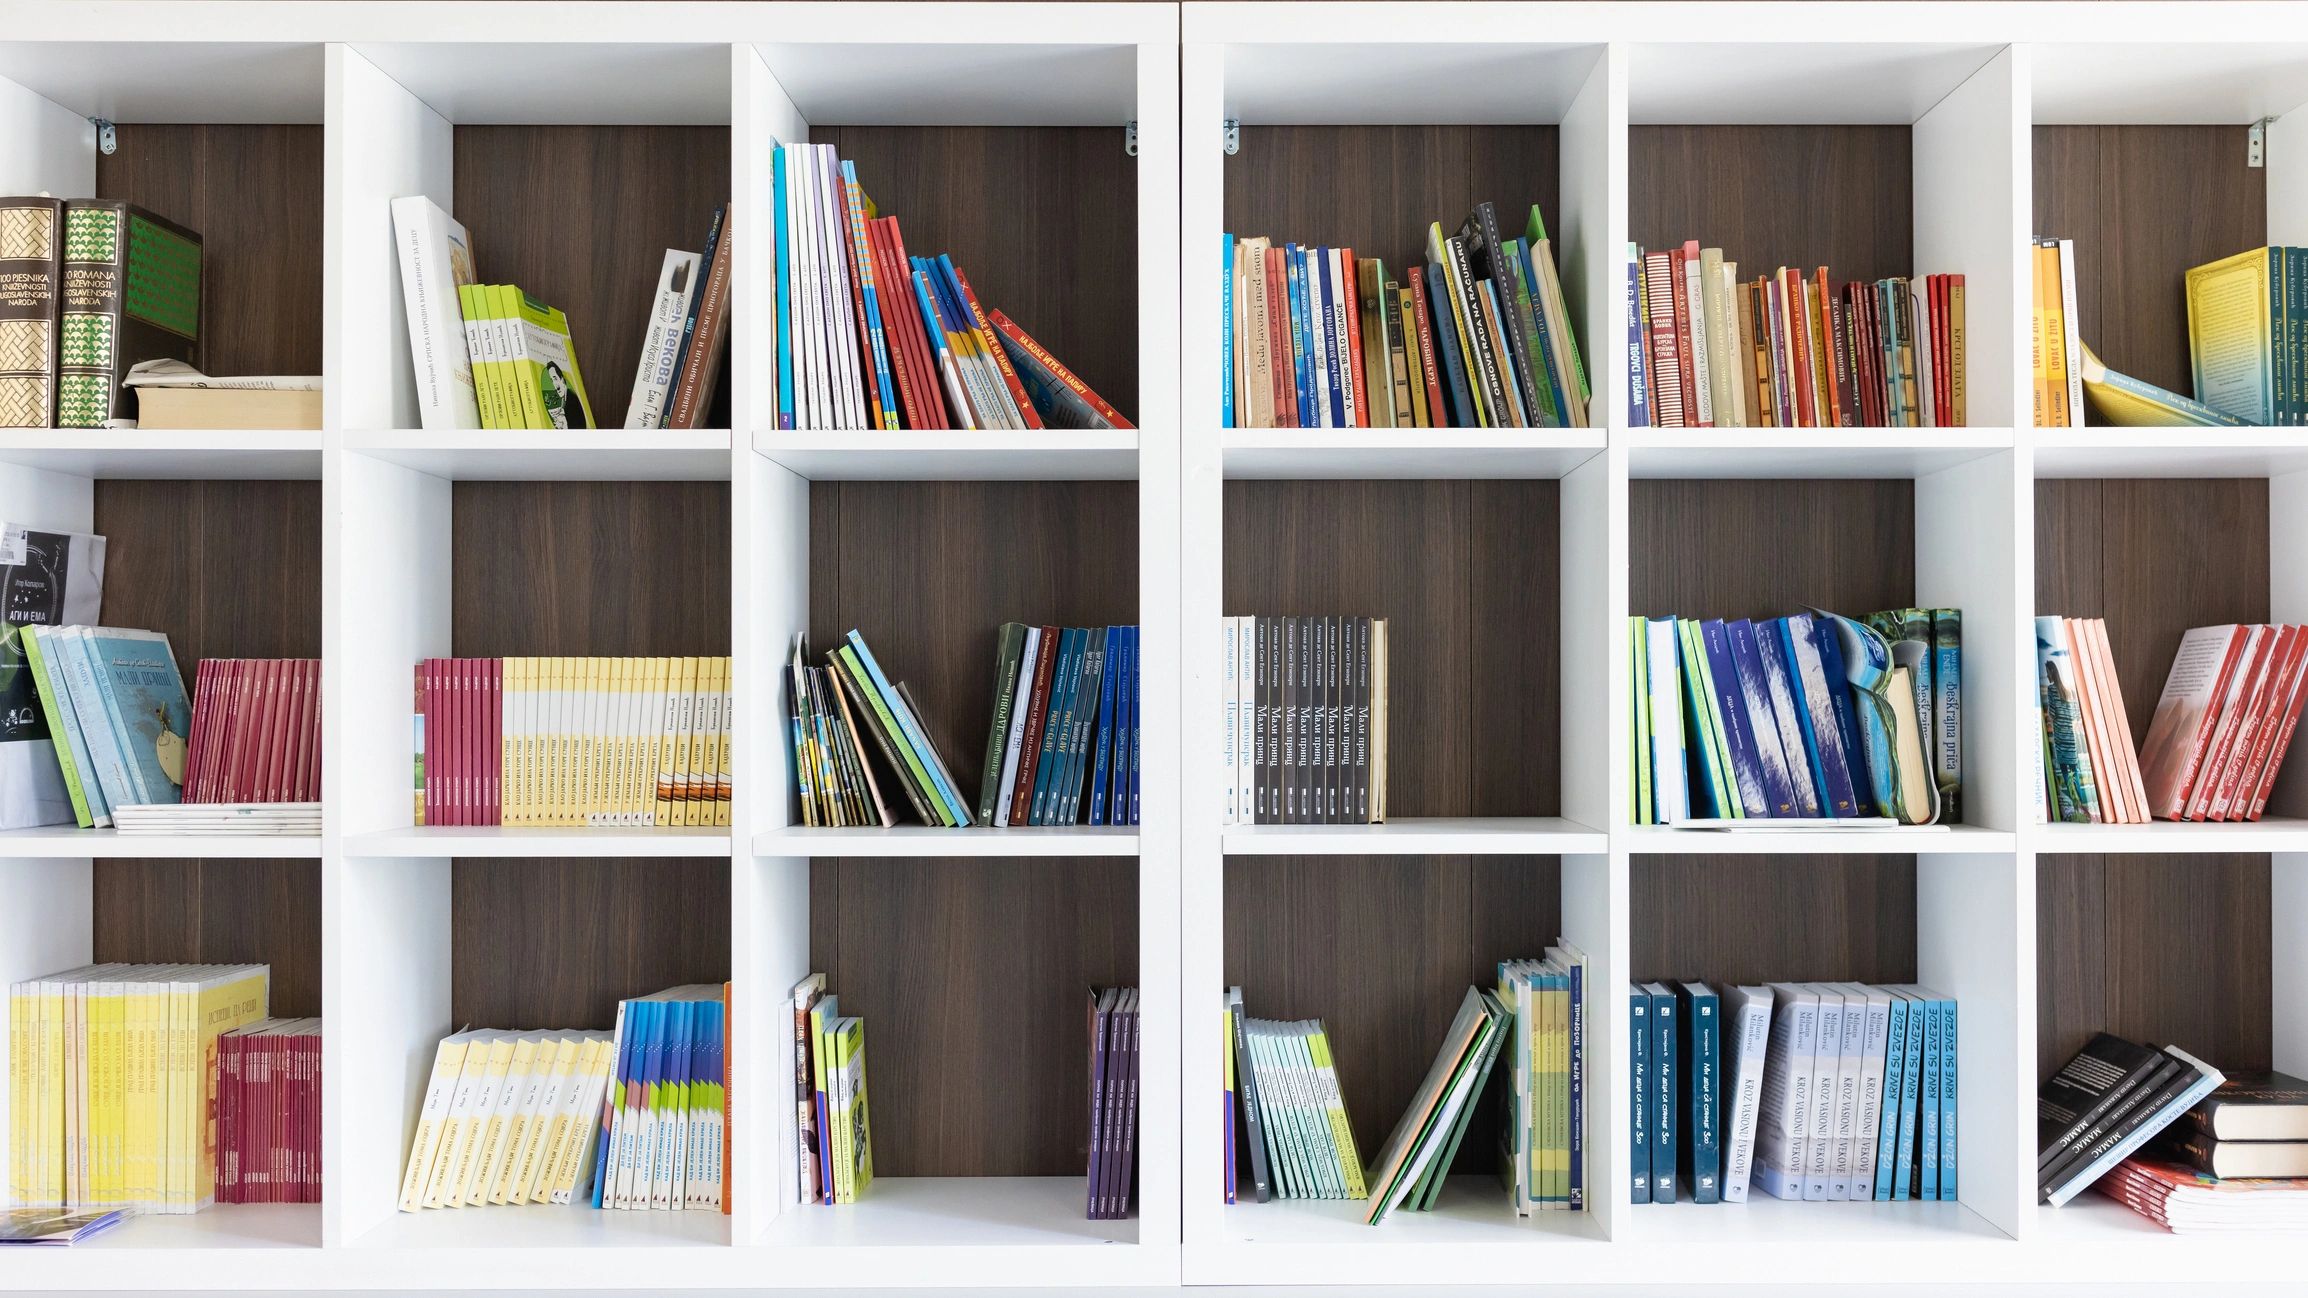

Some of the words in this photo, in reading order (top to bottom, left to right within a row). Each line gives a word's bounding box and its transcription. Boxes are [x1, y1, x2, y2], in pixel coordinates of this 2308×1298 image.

[73, 271, 115, 280] ROMANA
[1412, 273, 1421, 297] Сузана
[1454, 241, 1476, 300] RAČUNARU
[1415, 298, 1426, 324] Тамаро
[1471, 302, 1480, 317] NA
[1830, 296, 1840, 329] ДЕСАНКА
[1420, 327, 1432, 365] ЧАРОБНИ
[1475, 318, 1488, 349] RADA
[655, 327, 679, 387] векова
[983, 328, 996, 345] ИГРЕ
[991, 345, 1001, 354] НА
[996, 354, 1013, 377] ПАПИРУ
[1339, 337, 1348, 364] BIJELO
[1629, 342, 1640, 373] TRGOVCI
[1834, 331, 1846, 383] МАКСИМОВИЋ
[1954, 352, 1961, 366] ОД
[2051, 347, 2059, 369] LOVAC
[678, 385, 693, 423] СВАДБЕНИ
[688, 349, 702, 382] ОБИЧАЈИ
[700, 315, 711, 338] ПЕСМЕ
[1042, 355, 1059, 371] ИГРЕ
[1064, 374, 1086, 394] ПАПИРУ
[1341, 366, 1352, 399] Podgorec
[1426, 366, 1435, 387] КРУГ
[1483, 351, 1500, 396] OSNOVE
[1699, 369, 1707, 390] MAŠTE
[1631, 375, 1643, 404] DUŠAMA
[1701, 391, 1710, 420] PLODOVI
[9, 611, 21, 620] АГИ
[23, 612, 28, 620] И
[30, 612, 45, 620] ЕМА
[995, 693, 1010, 733] ДАРОВИ
[1256, 704, 1267, 733] Мали
[1299, 706, 1310, 734] Мали
[1327, 706, 1338, 734] Мали
[1357, 706, 1368, 733] Мали
[1942, 682, 1960, 737] Beskrajna
[1254, 736, 1265, 765] принц
[1298, 737, 1309, 767] принц
[1325, 737, 1336, 767] принц
[1355, 737, 1366, 767] принц
[1942, 742, 1956, 769] priča
[1754, 1014, 1763, 1040] Milutin
[1804, 1011, 1812, 1037] Milutin
[1874, 1012, 1883, 1038] Milutin
[1892, 1009, 1904, 1052] ZVEZDE
[1945, 1009, 1953, 1051] ZVEZDE
[1890, 1055, 1900, 1068] SU
[1945, 1056, 1953, 1067] SU
[1743, 1079, 1753, 1101] KROZ
[1796, 1076, 1805, 1098] KROZ
[1865, 1077, 1874, 1099] KROZ
[1888, 1071, 1898, 1099] KRIVE
[1945, 1071, 1953, 1099] KRIVE
[1739, 1103, 1750, 1137] VASIONU
[1793, 1100, 1804, 1134] VASIONU
[1862, 1101, 1872, 1135] VASIONU
[1885, 1111, 1895, 1136] GRIN
[1944, 1111, 1953, 1135] GRIN
[2059, 1120, 2089, 1147] MAMAC
[2072, 1127, 2101, 1154] MAMAC
[2091, 1131, 2121, 1158] MAMAC
[1734, 1143, 1746, 1175] VEKOVE
[1790, 1141, 1801, 1172] VEKOVE
[1859, 1142, 1869, 1173] VEKOVE
[1880, 1138, 1894, 1168] DŽON
[1942, 1138, 1954, 1168] DŽON
